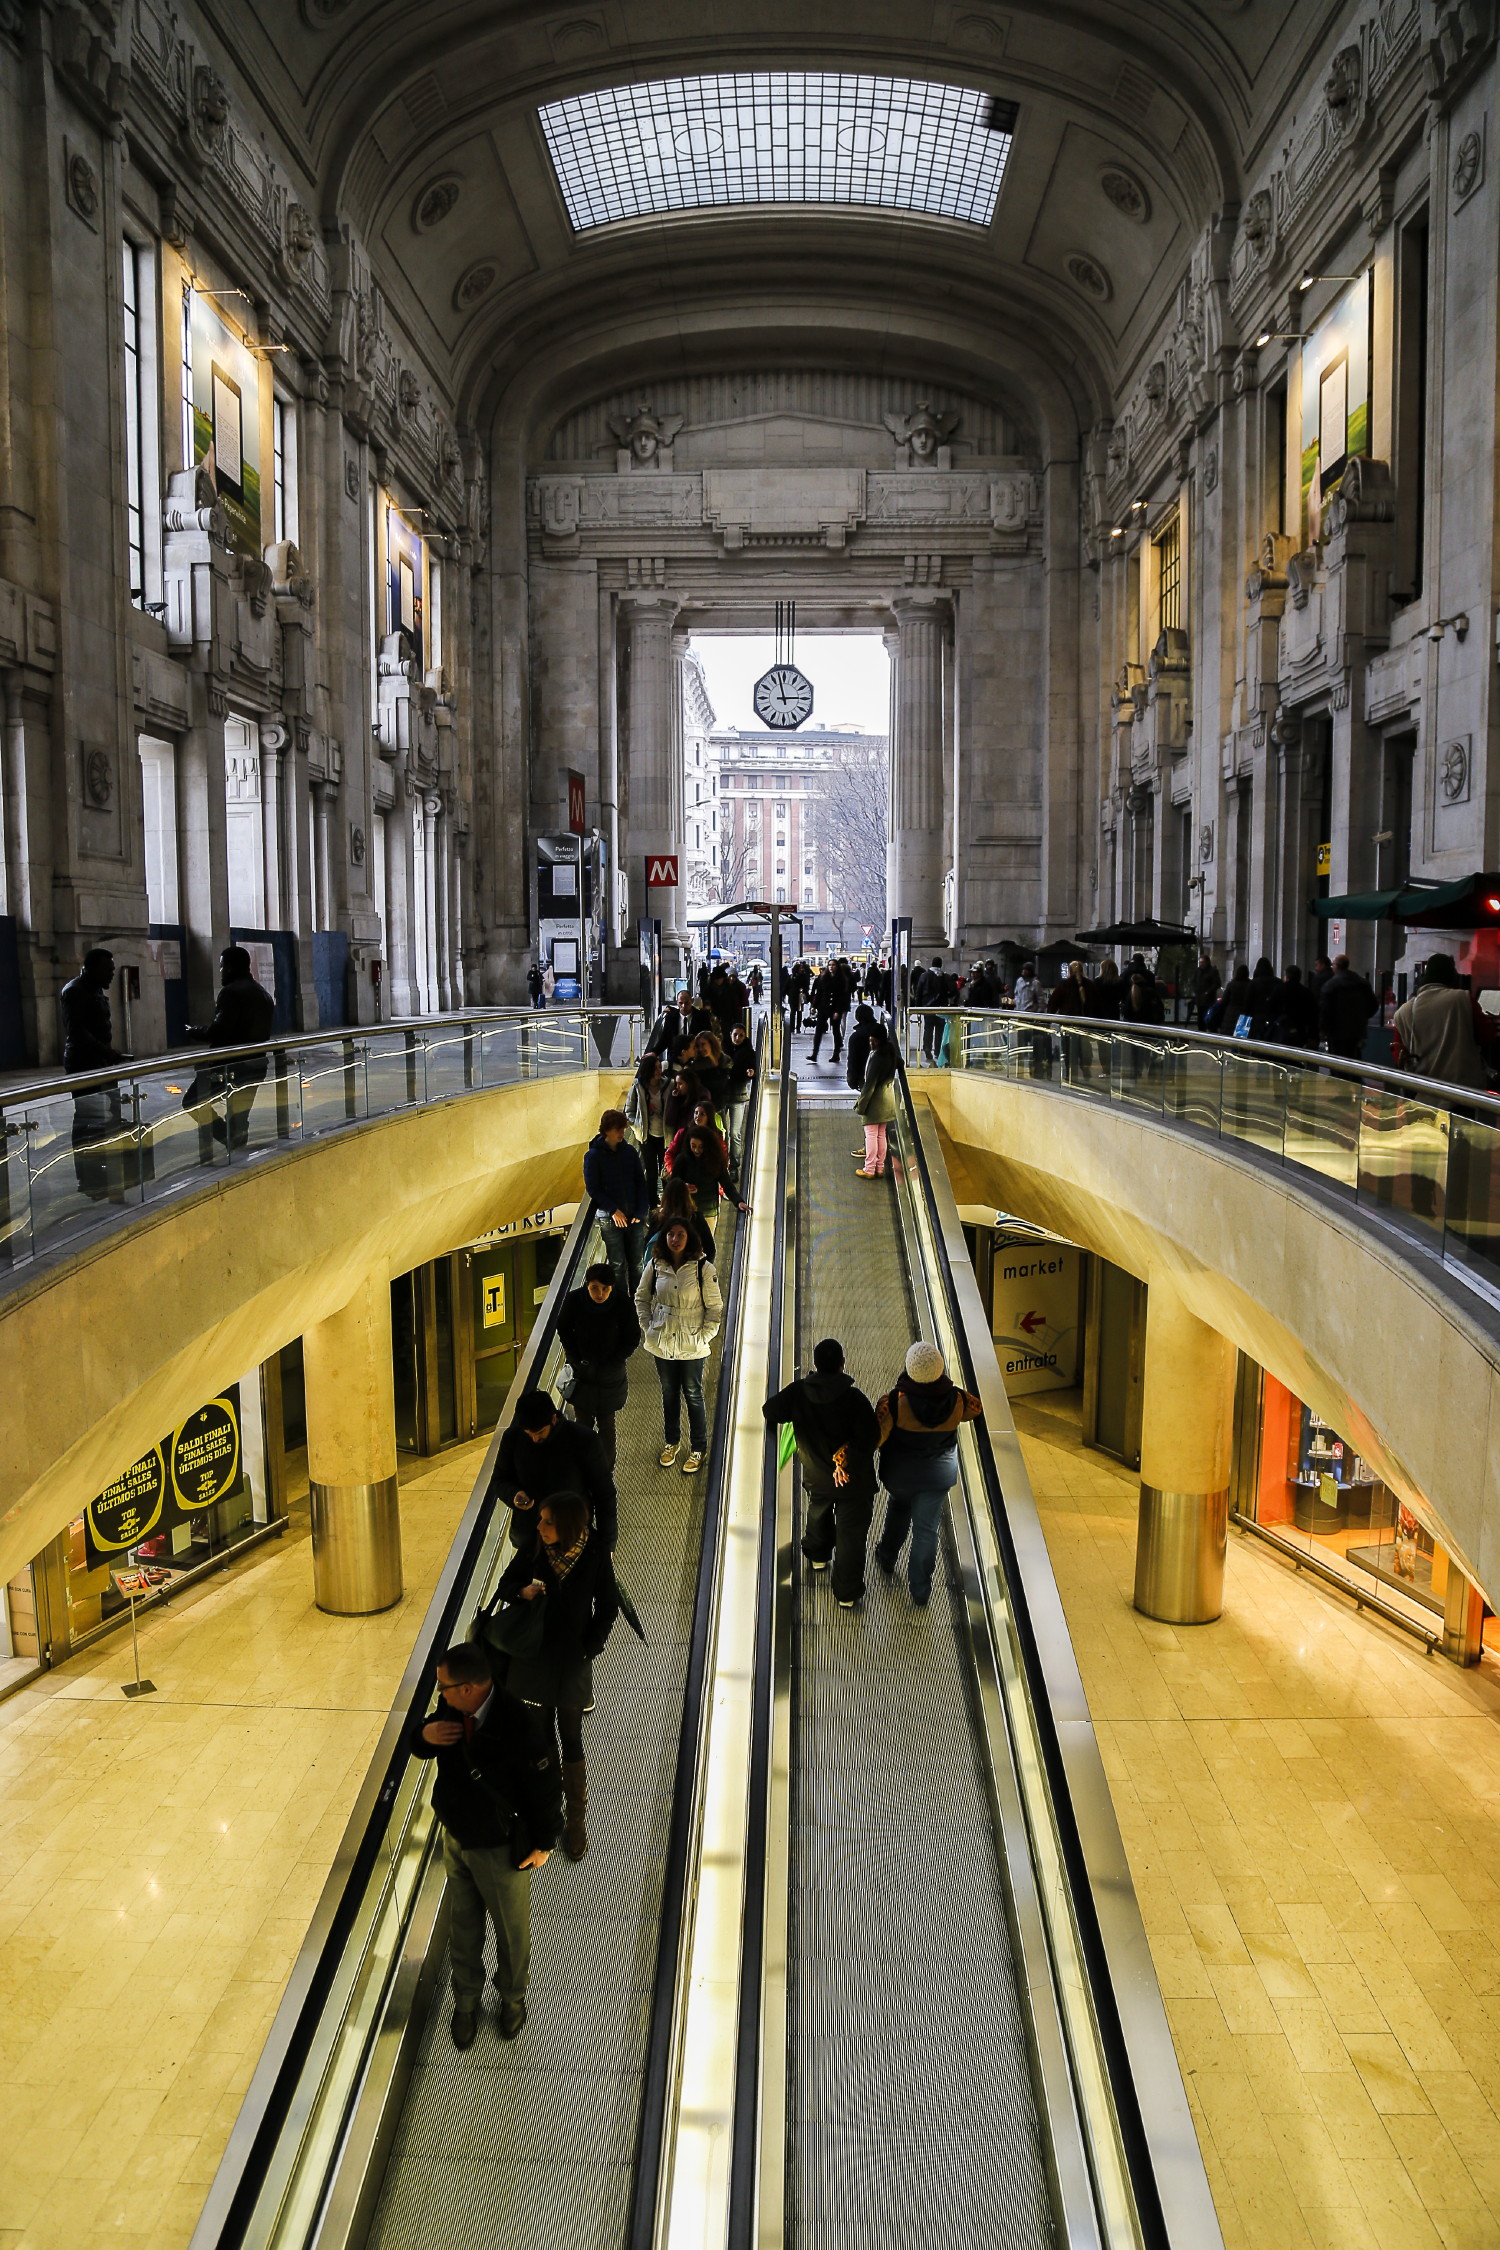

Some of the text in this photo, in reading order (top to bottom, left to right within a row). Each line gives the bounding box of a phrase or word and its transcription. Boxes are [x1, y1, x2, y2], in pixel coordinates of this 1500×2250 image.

[571, 787, 584, 823] M
[649, 860, 677, 881] M
[1003, 1257, 1064, 1279] market
[487, 1286, 501, 1312] T
[1006, 1353, 1057, 1372] entrata
[177, 1423, 232, 1454] SALDI FINALI
[183, 1436, 227, 1462] FINAL SALES
[178, 1444, 232, 1475] ÚLTIMOS DIAS
[102, 1483, 127, 1500] FINAL
[127, 1470, 152, 1488] SALES
[200, 1470, 214, 1482] TOP
[97, 1488, 136, 1514] ÚLTIMOS
[137, 1478, 158, 1496] DIAS
[198, 1488, 215, 1500] SALES
[121, 1507, 137, 1521] TOP
